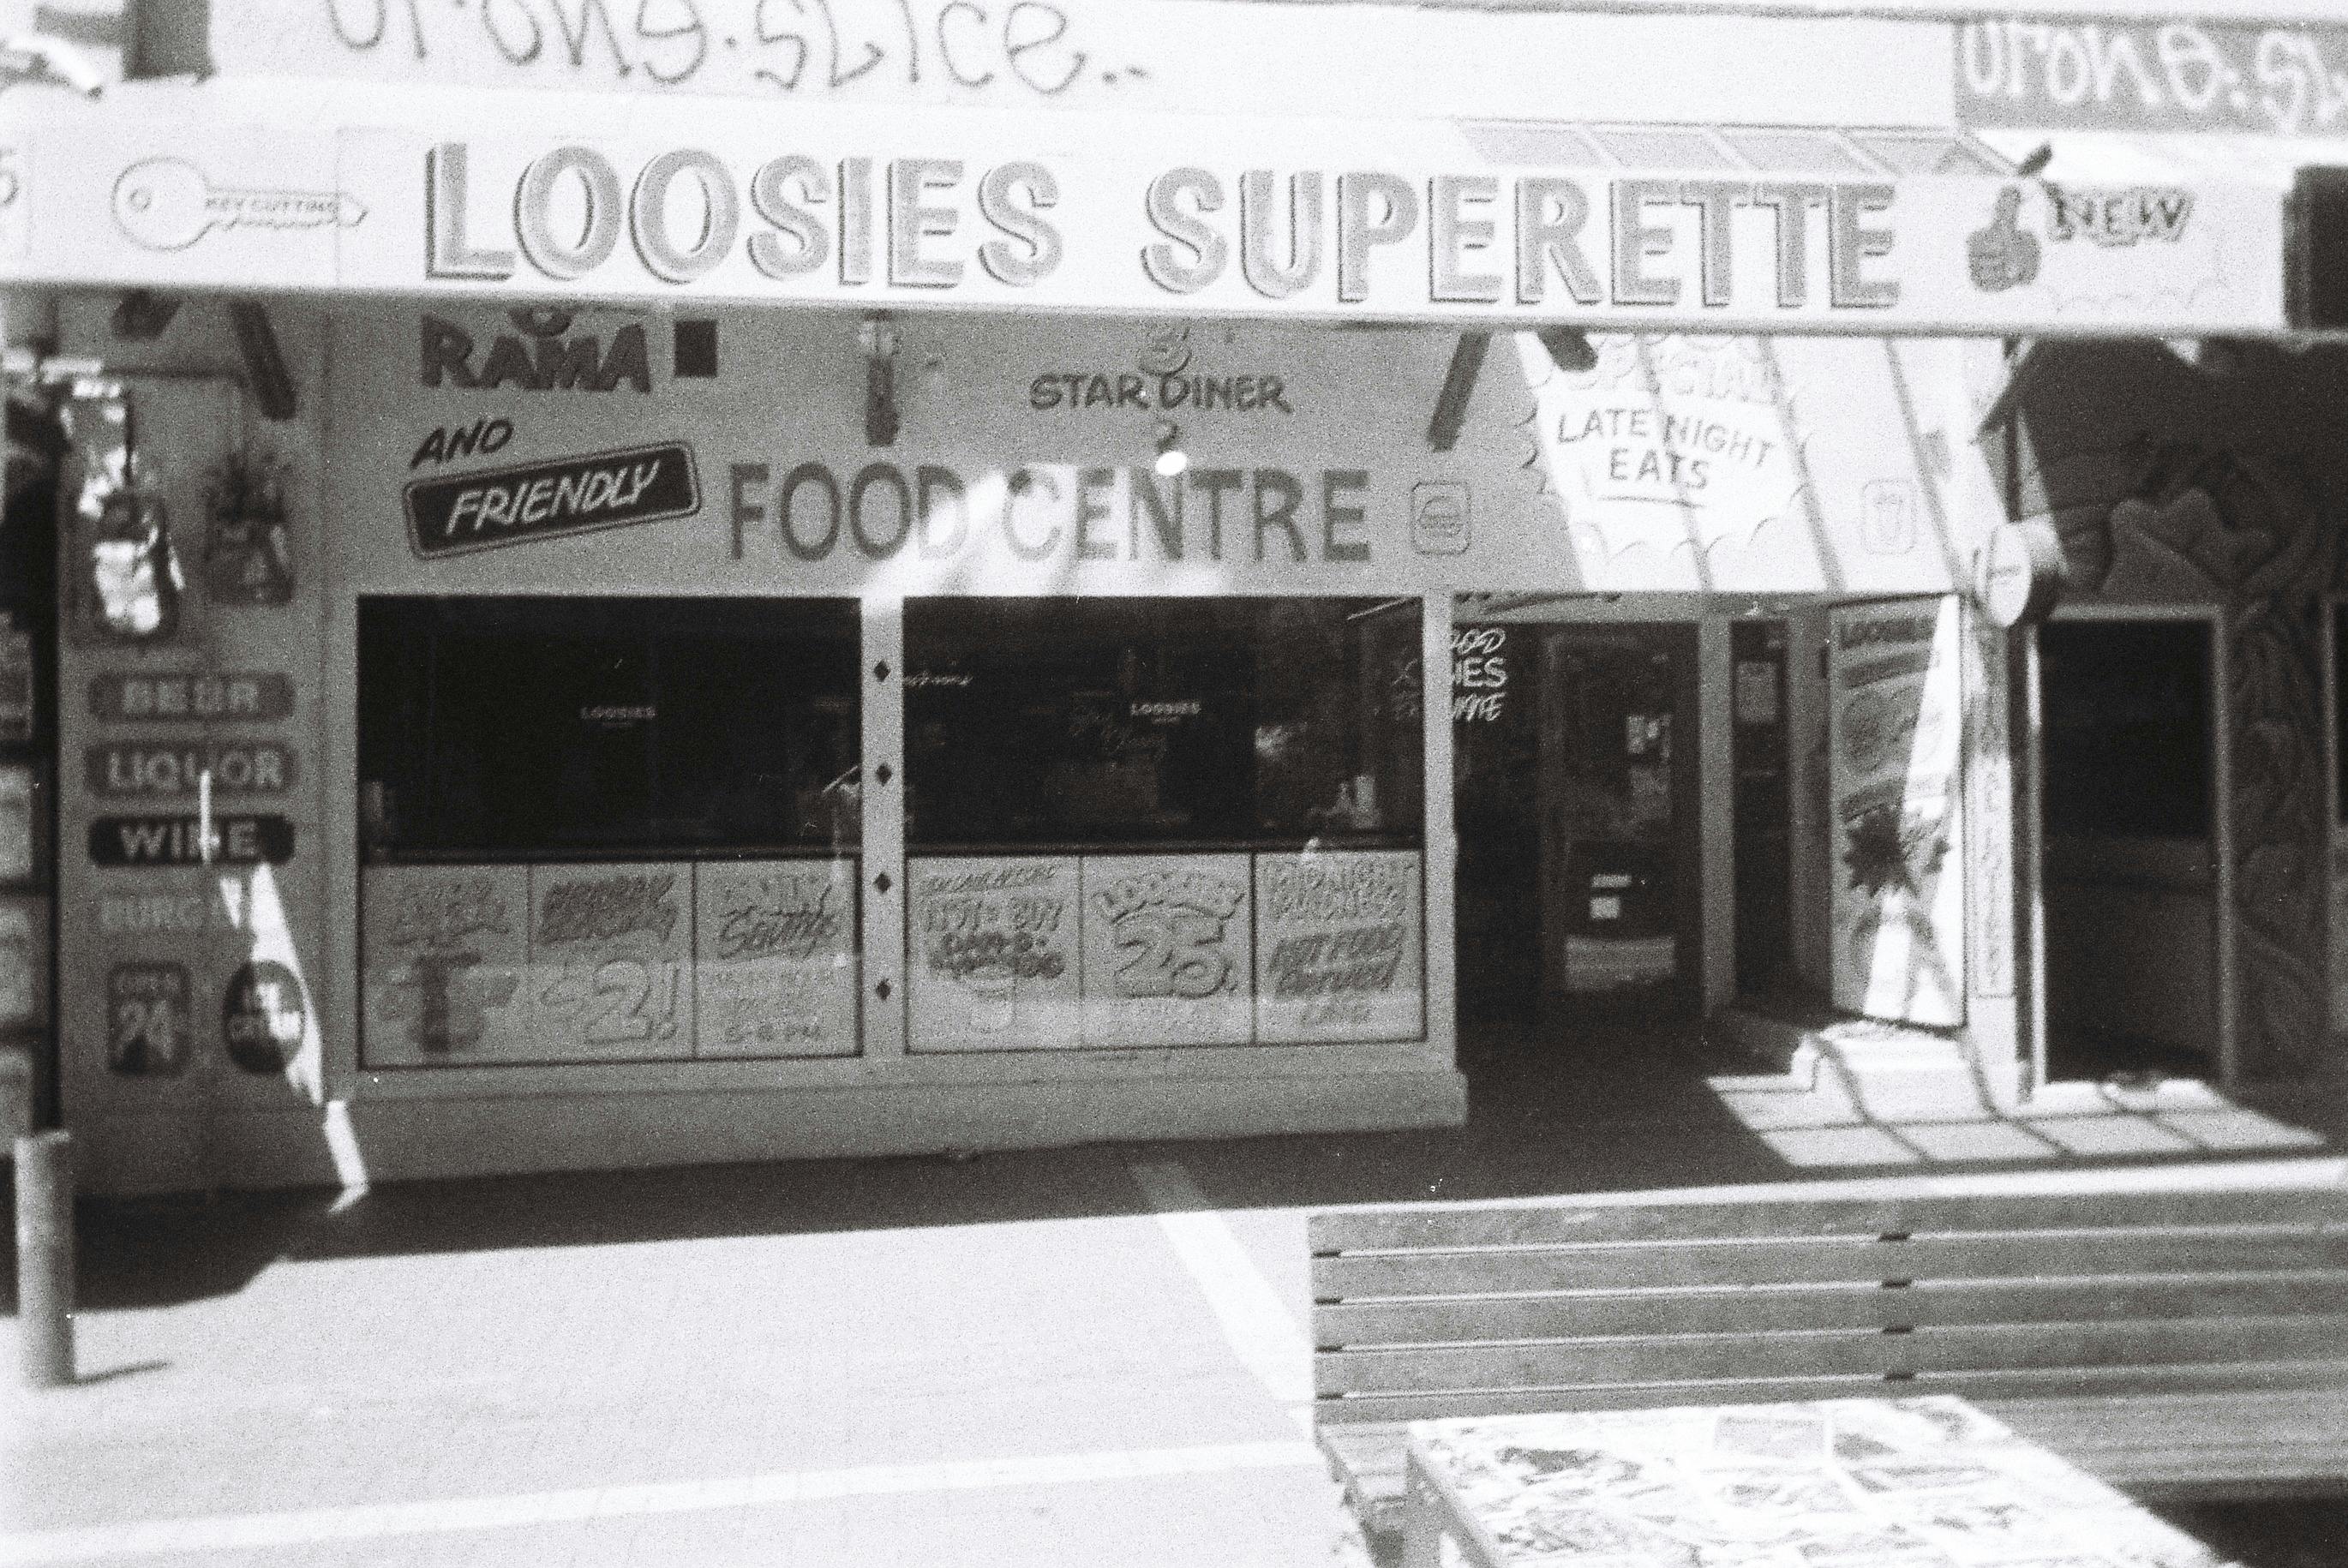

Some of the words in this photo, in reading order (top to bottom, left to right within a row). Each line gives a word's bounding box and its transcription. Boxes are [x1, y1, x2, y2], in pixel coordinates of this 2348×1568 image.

[426, 142, 1063, 288] LOOSIES
[1141, 166, 1900, 309] SUPERETTE
[2050, 183, 2195, 248] NEW
[422, 314, 651, 394] RAMA
[1028, 373, 1148, 410] STAR
[1156, 374, 1295, 415] DINER
[409, 418, 513, 470] AND
[1556, 408, 1653, 445] LATE
[1662, 413, 1775, 469] NIGHT
[1608, 446, 1710, 490] EATS
[446, 459, 662, 535] FRIENDLY
[730, 460, 969, 561] FOOD
[1003, 466, 1372, 563] CENTRE
[107, 750, 283, 790] LIQUOR
